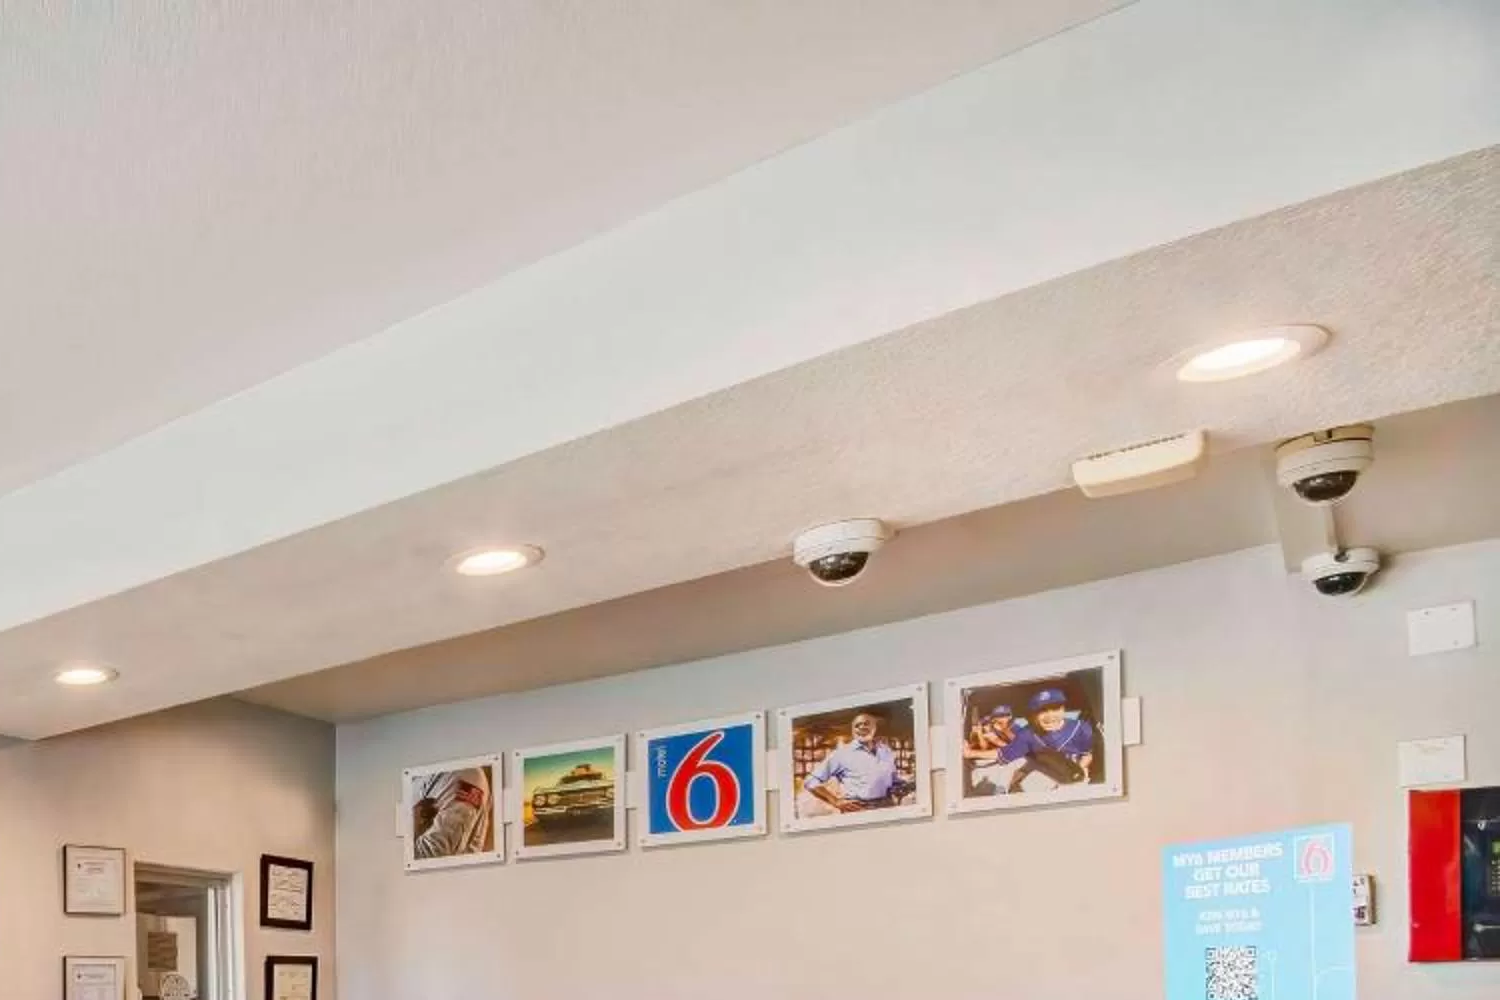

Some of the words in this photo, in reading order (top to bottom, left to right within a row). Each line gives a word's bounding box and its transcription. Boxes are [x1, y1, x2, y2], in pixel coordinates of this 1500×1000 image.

[666, 731, 740, 832] 6
[1193, 867, 1222, 881] GET
[1224, 863, 1260, 879] OUR
[1184, 882, 1221, 900] BEST
[1223, 878, 1271, 896] RATES
